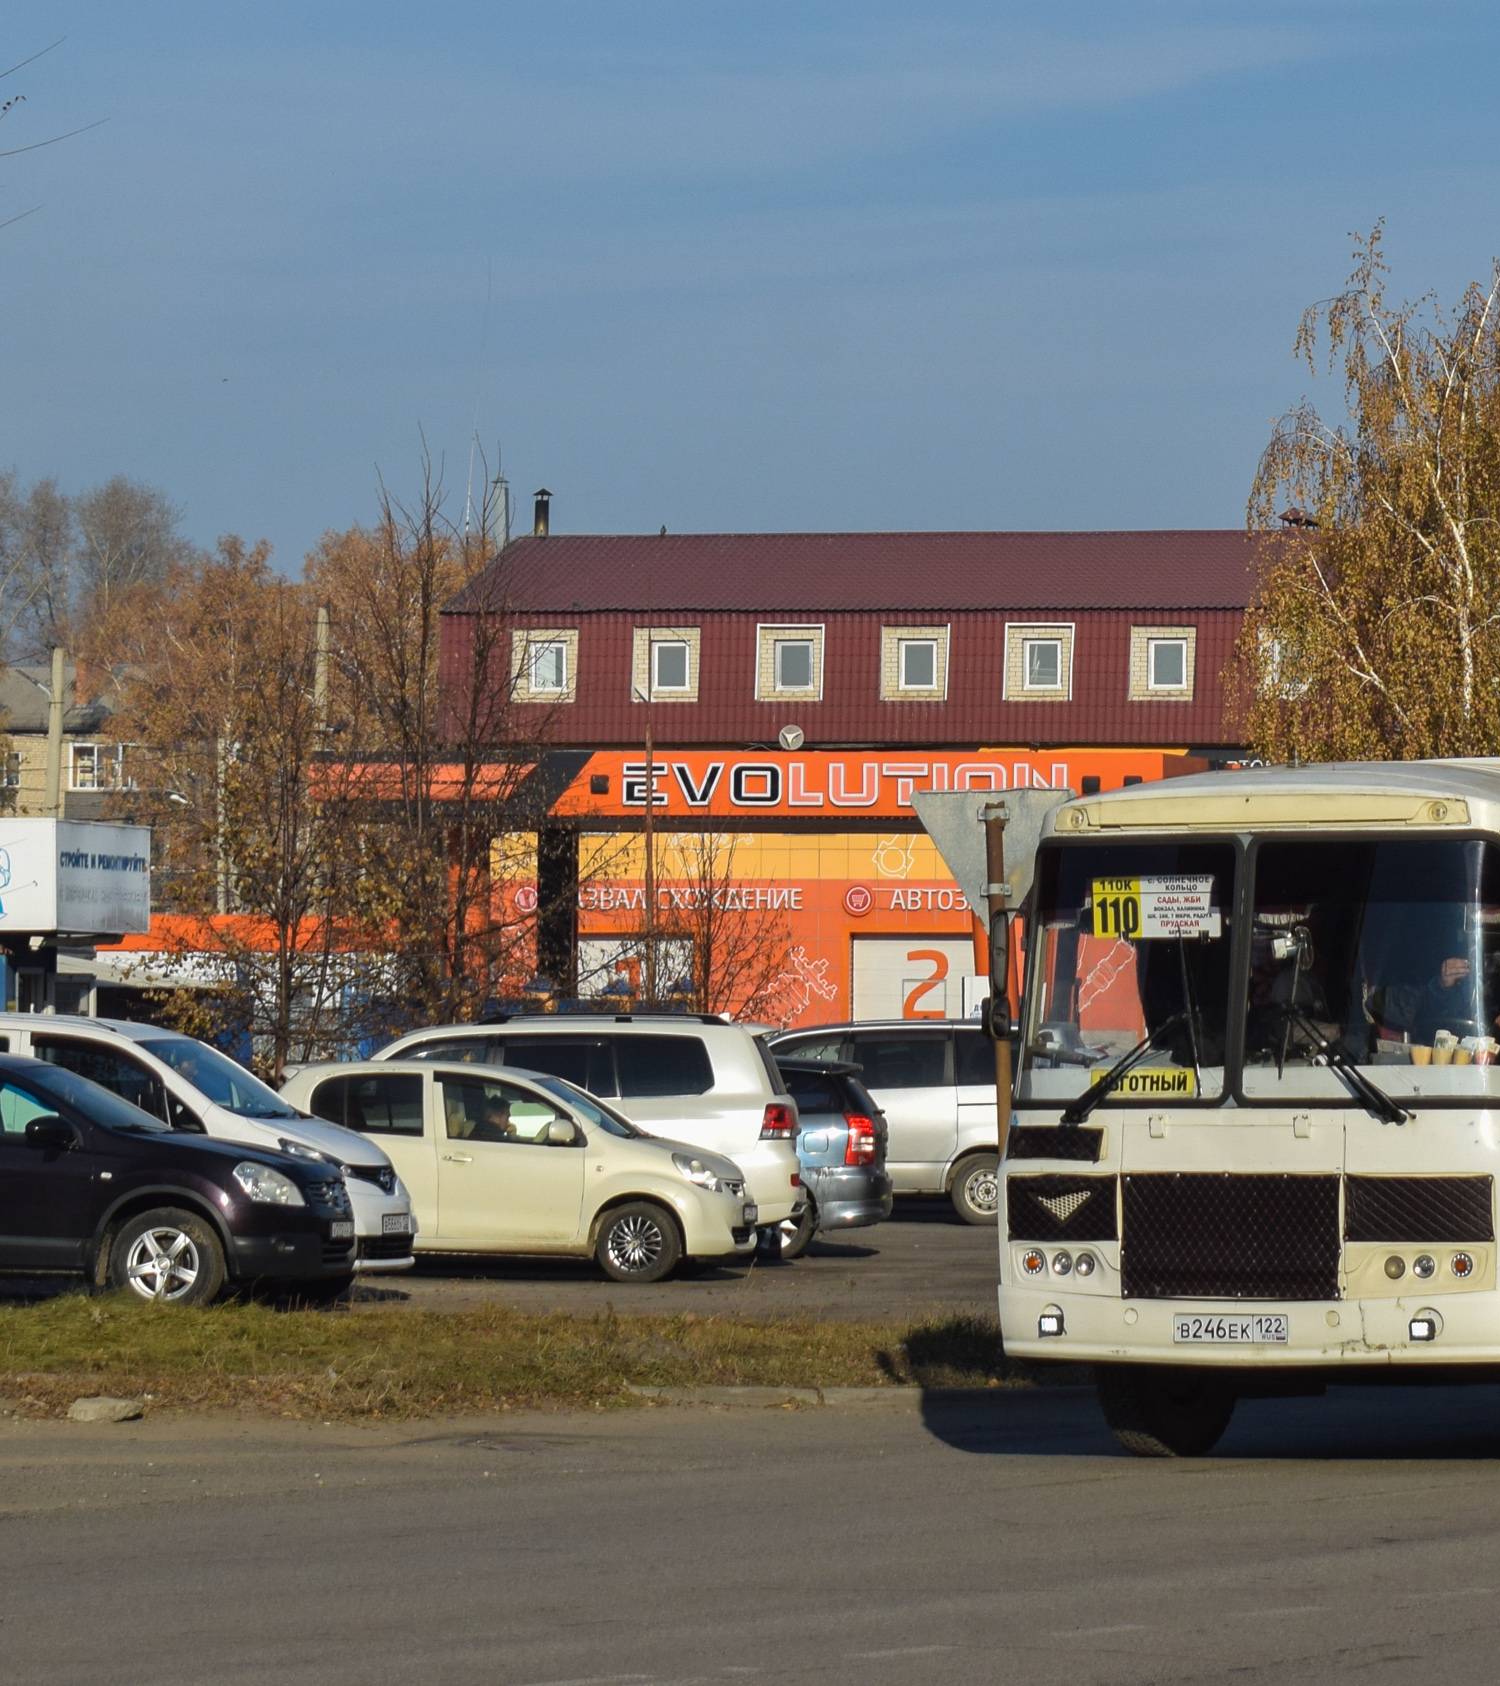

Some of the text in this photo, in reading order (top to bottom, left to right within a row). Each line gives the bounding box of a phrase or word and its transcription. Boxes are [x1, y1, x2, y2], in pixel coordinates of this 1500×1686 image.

[60, 848, 88, 869] СТРОЙТЕ
[1099, 879, 1132, 891] 110К
[1165, 884, 1198, 892] КОЛЬЦО
[578, 888, 646, 911] ЗВАЛ
[889, 888, 972, 911] АВТОЗ
[1096, 896, 1139, 934] 110
[1160, 920, 1200, 928] ПРУДСКАЯ
[903, 949, 949, 1020] 2
[1180, 1318, 1282, 1339] В246ЕК 122
